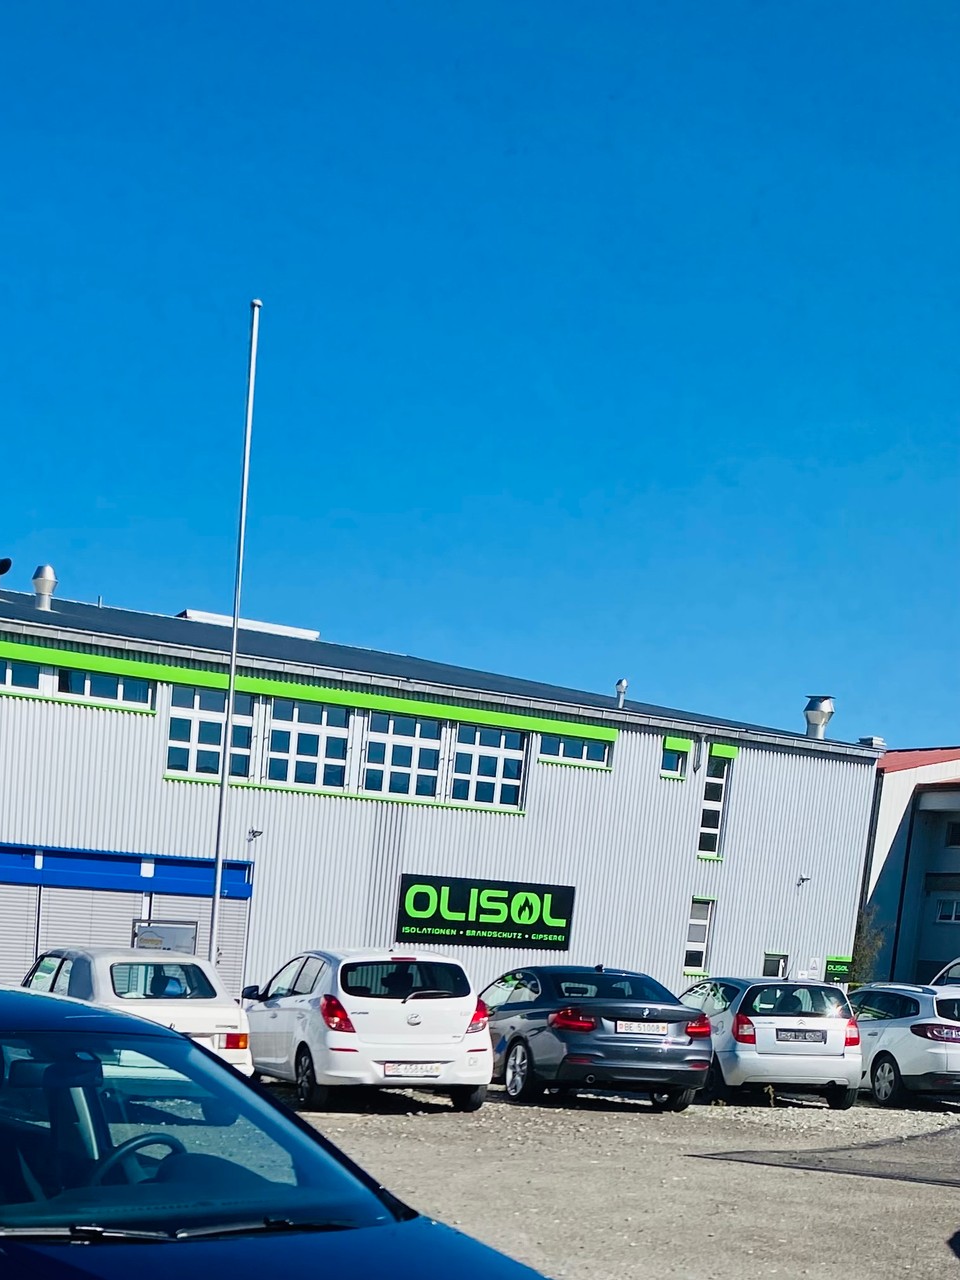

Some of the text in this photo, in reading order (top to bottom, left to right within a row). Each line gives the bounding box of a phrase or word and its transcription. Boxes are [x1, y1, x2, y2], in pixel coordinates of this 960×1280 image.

[404, 884, 567, 927] OLISOL
[402, 926, 565, 942] ISOLATIONEN BRANDSCHUTZ GIPSEREI
